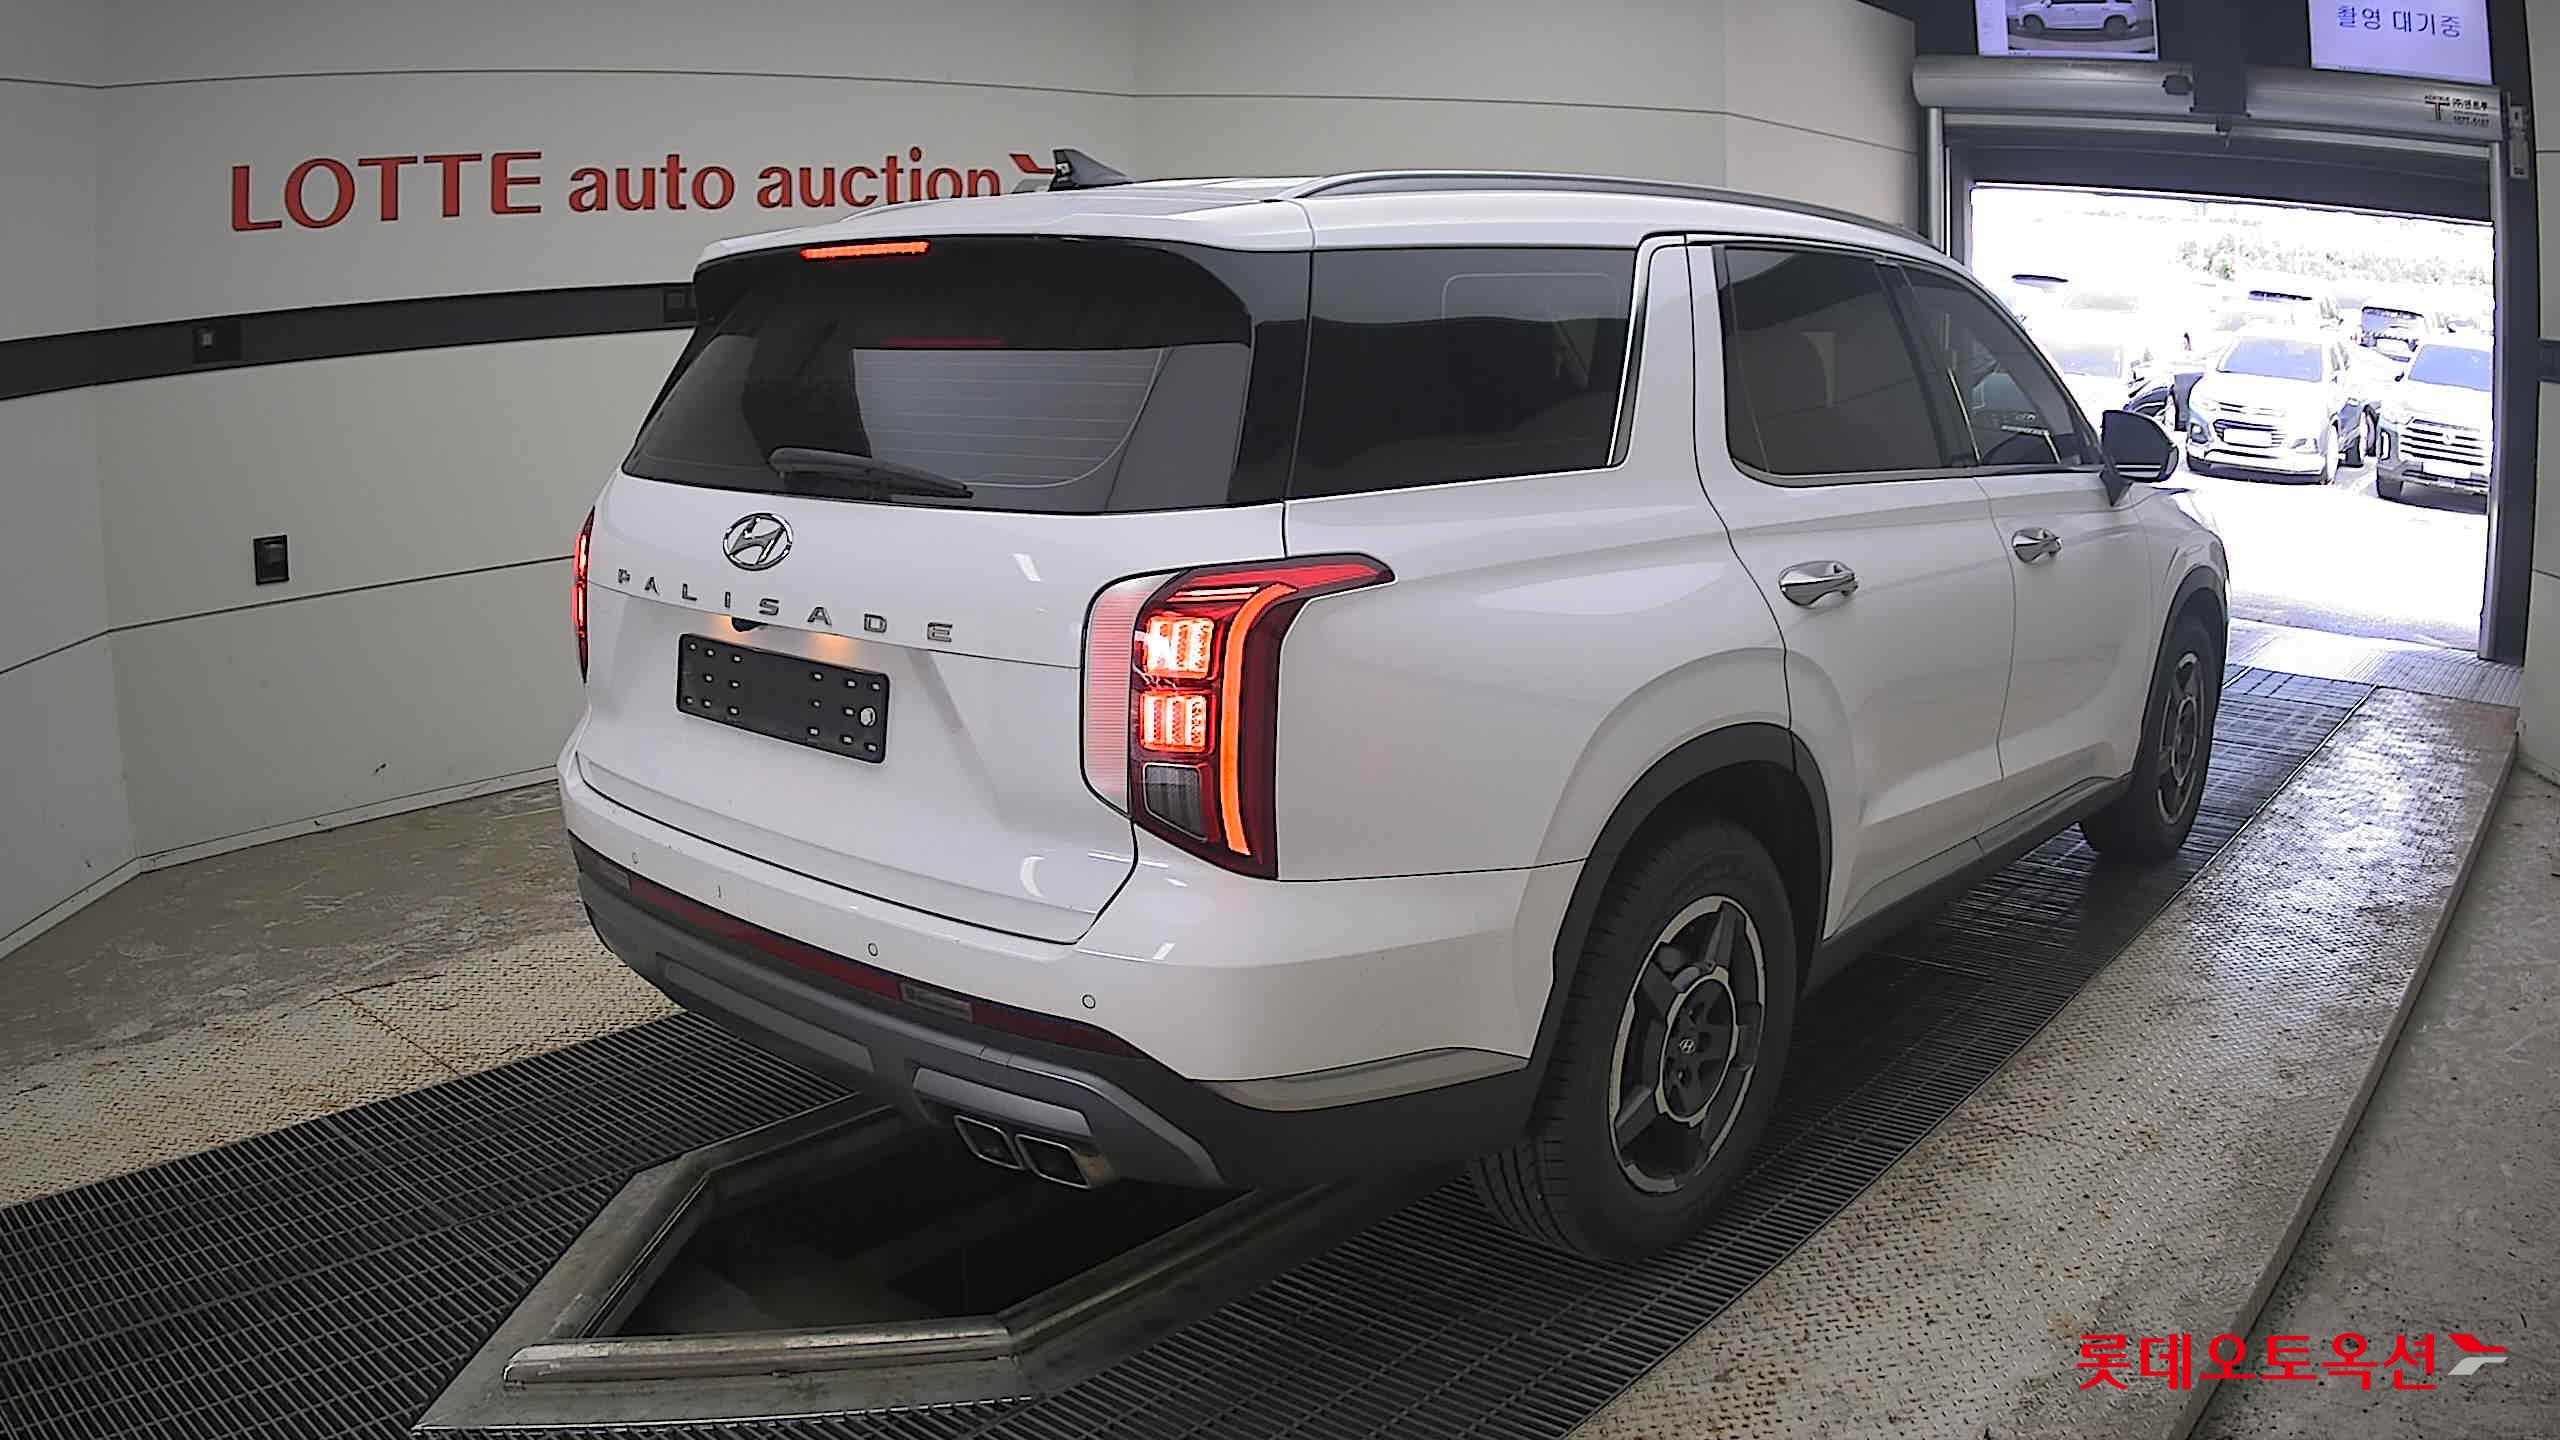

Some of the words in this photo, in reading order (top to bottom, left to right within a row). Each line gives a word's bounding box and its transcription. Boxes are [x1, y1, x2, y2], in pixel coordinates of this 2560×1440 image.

[2337, 5, 2382, 31] 촬영
[2392, 9, 2462, 39] 대기중
[231, 151, 543, 233] LOTTE
[568, 152, 736, 212] auto
[756, 147, 1003, 208] auction
[617, 567, 954, 644] PALISADE
